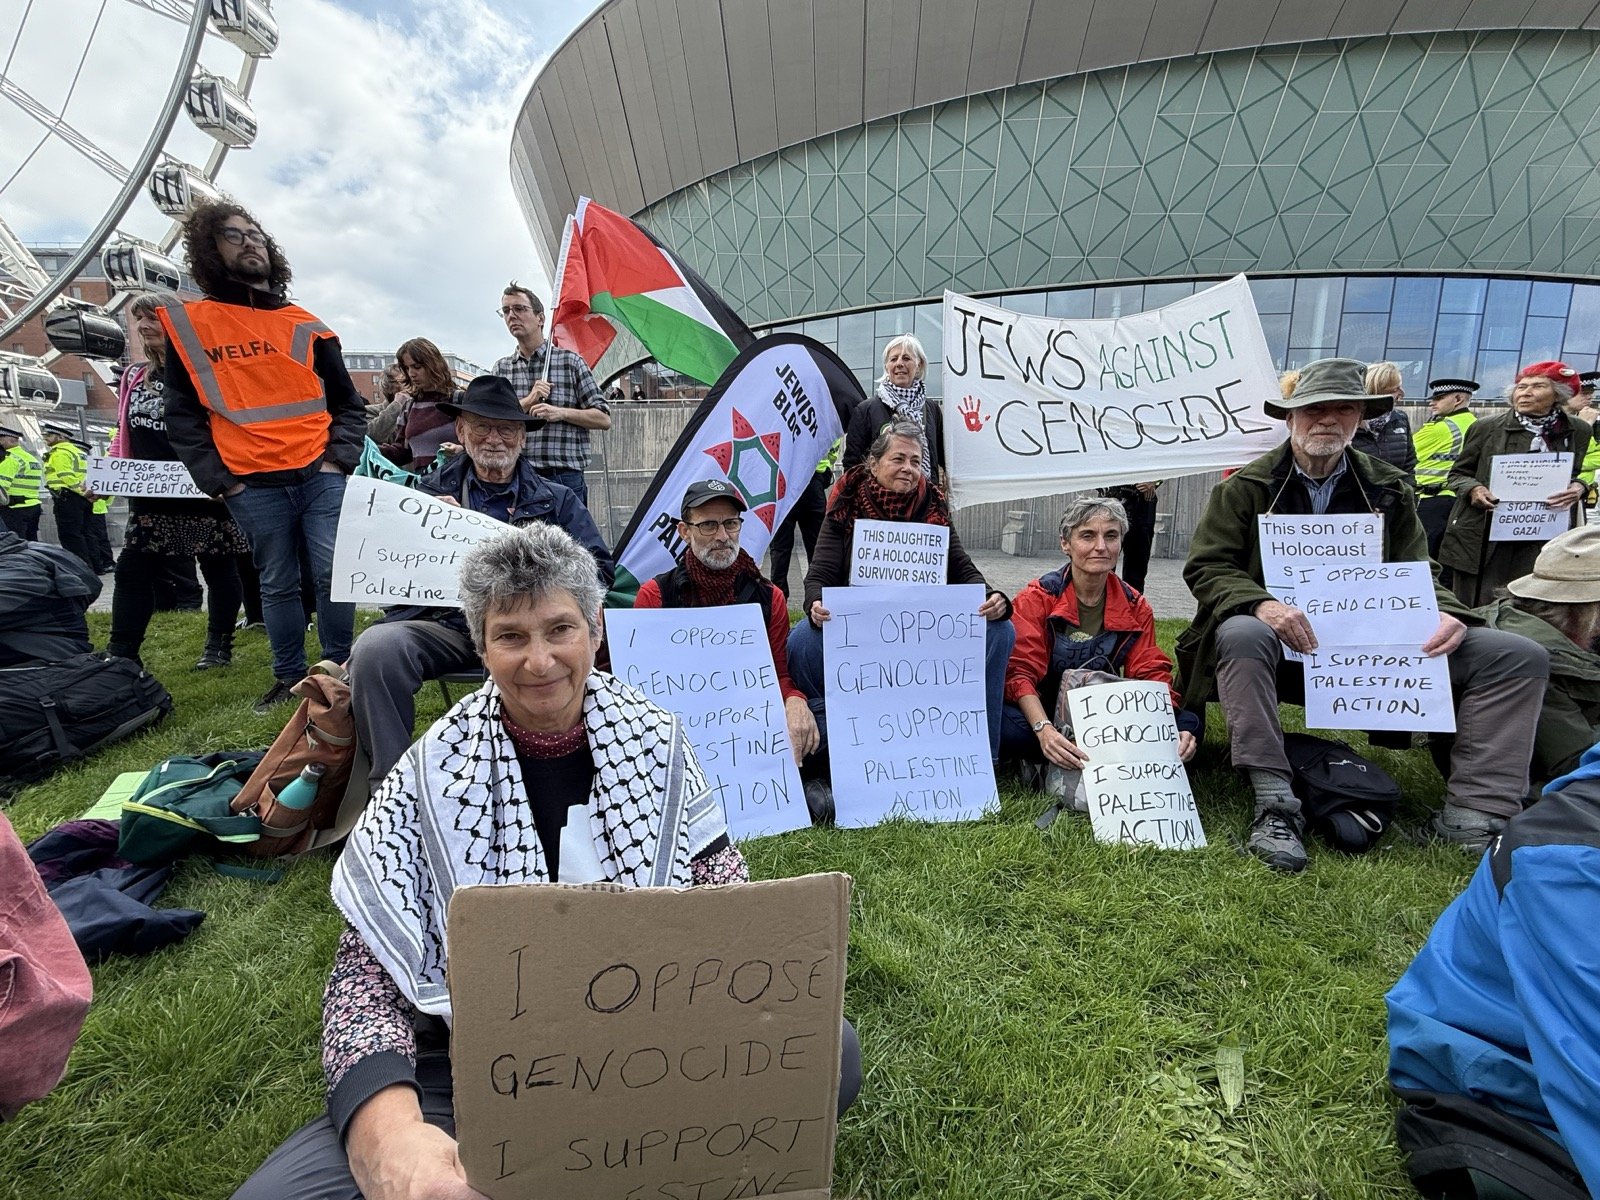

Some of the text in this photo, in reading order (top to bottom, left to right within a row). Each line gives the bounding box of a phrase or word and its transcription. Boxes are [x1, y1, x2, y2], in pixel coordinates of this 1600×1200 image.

[204, 341, 278, 363] WELFA
[946, 306, 1235, 391] JEWS AGAINST
[776, 363, 818, 439] JEWISH
[130, 416, 167, 431] CONSCI
[773, 389, 802, 444] BLOC
[994, 379, 1273, 457] GENOCIDE
[93, 459, 188, 472] I OPPOSE GENO
[119, 472, 183, 482] I SUPPORT
[91, 480, 205, 495] SILENCE ELBIT DRO
[367, 488, 376, 516] I
[1507, 502, 1532, 512] STOP
[1261, 521, 1375, 535] This son of a
[1498, 513, 1557, 524] GENOCIDE IN
[863, 530, 942, 547] THIS DAUGHTER
[1512, 527, 1542, 535] GAZA!
[358, 538, 460, 569] I support
[857, 547, 944, 566] OF A HOLOCAUST
[1271, 541, 1367, 557] Holocaust
[350, 571, 445, 600] Palestine
[858, 566, 941, 584] SURVIVOR SAYS:
[1299, 568, 1315, 583] I
[1327, 567, 1413, 582] OPPOSE
[1306, 596, 1431, 616] GENOCIDE.
[629, 627, 757, 648] I OPPOSE
[836, 610, 983, 649] I OPPOSE
[1310, 653, 1323, 669] I
[1328, 653, 1431, 667] SUPPORT
[837, 657, 979, 694] GENOCIDE
[1311, 675, 1433, 690] PALESTINE
[673, 700, 774, 728] UPPORT
[1080, 690, 1174, 720] I OPPOSE
[1332, 697, 1427, 718] ACTION.
[847, 706, 986, 746] I SUPPORT
[1082, 724, 1178, 748] GENOCIDE
[692, 731, 790, 767] STINE
[864, 754, 988, 784] PALESTINE
[1093, 763, 1184, 785] I SUPPORT
[712, 758, 791, 825] TION
[891, 787, 963, 813] ACTION
[1098, 792, 1196, 816] PALESTINE
[1120, 818, 1196, 844] ACTION
[508, 944, 829, 1020] I OPPOSE
[490, 1032, 817, 1099] GENOCIDE
[492, 1116, 824, 1180] I SUPPORT
